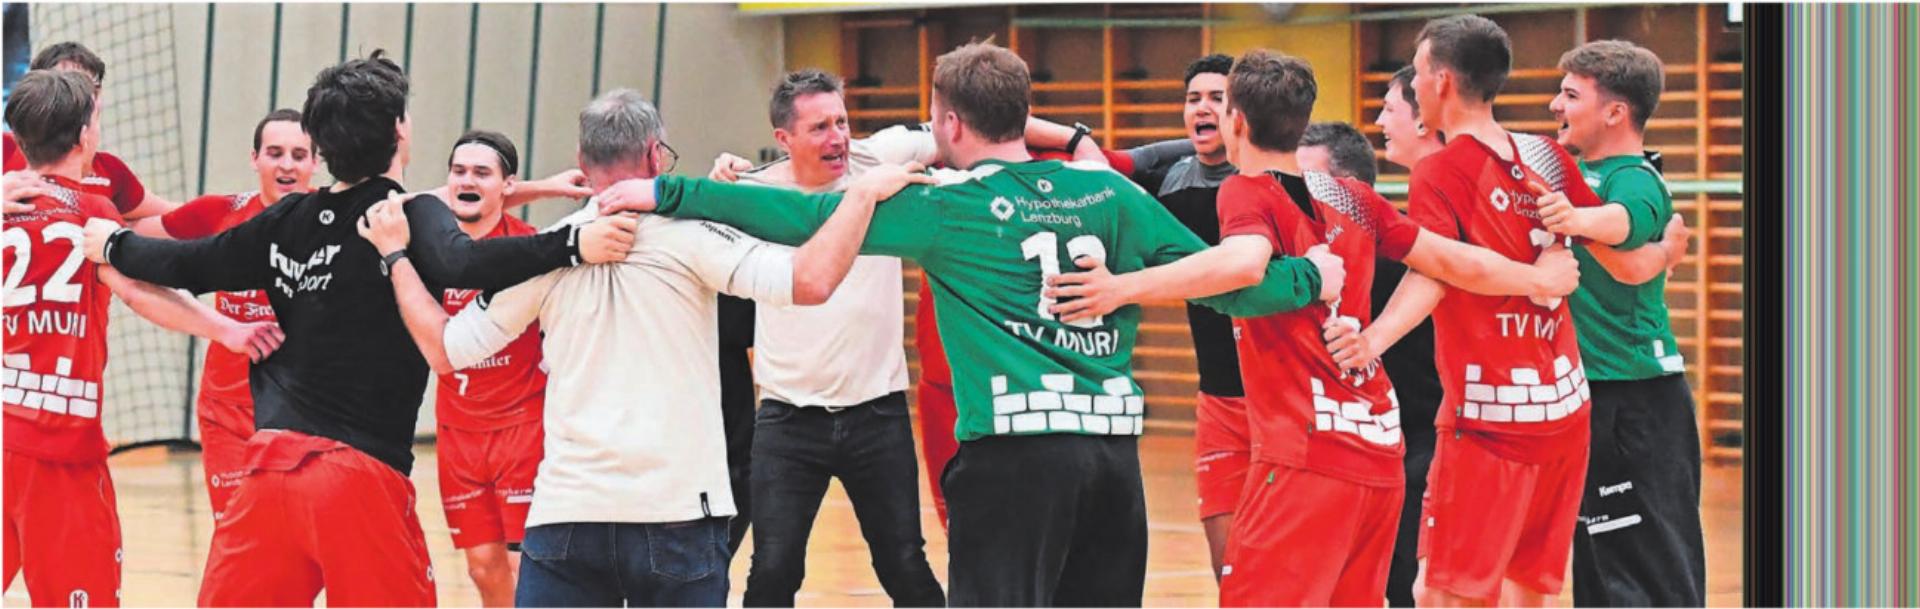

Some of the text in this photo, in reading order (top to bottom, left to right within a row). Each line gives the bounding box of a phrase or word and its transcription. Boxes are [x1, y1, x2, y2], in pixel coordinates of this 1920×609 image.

[1014, 185, 1116, 211] Hypothekarbank
[1020, 210, 1082, 229] Lenzburg
[2, 220, 84, 307] 22
[2, 313, 19, 336] V
[1496, 312, 1529, 338] TV
[1004, 319, 1120, 357] TV MURI
[453, 372, 470, 396] 7
[1598, 480, 1633, 498] Kempa
